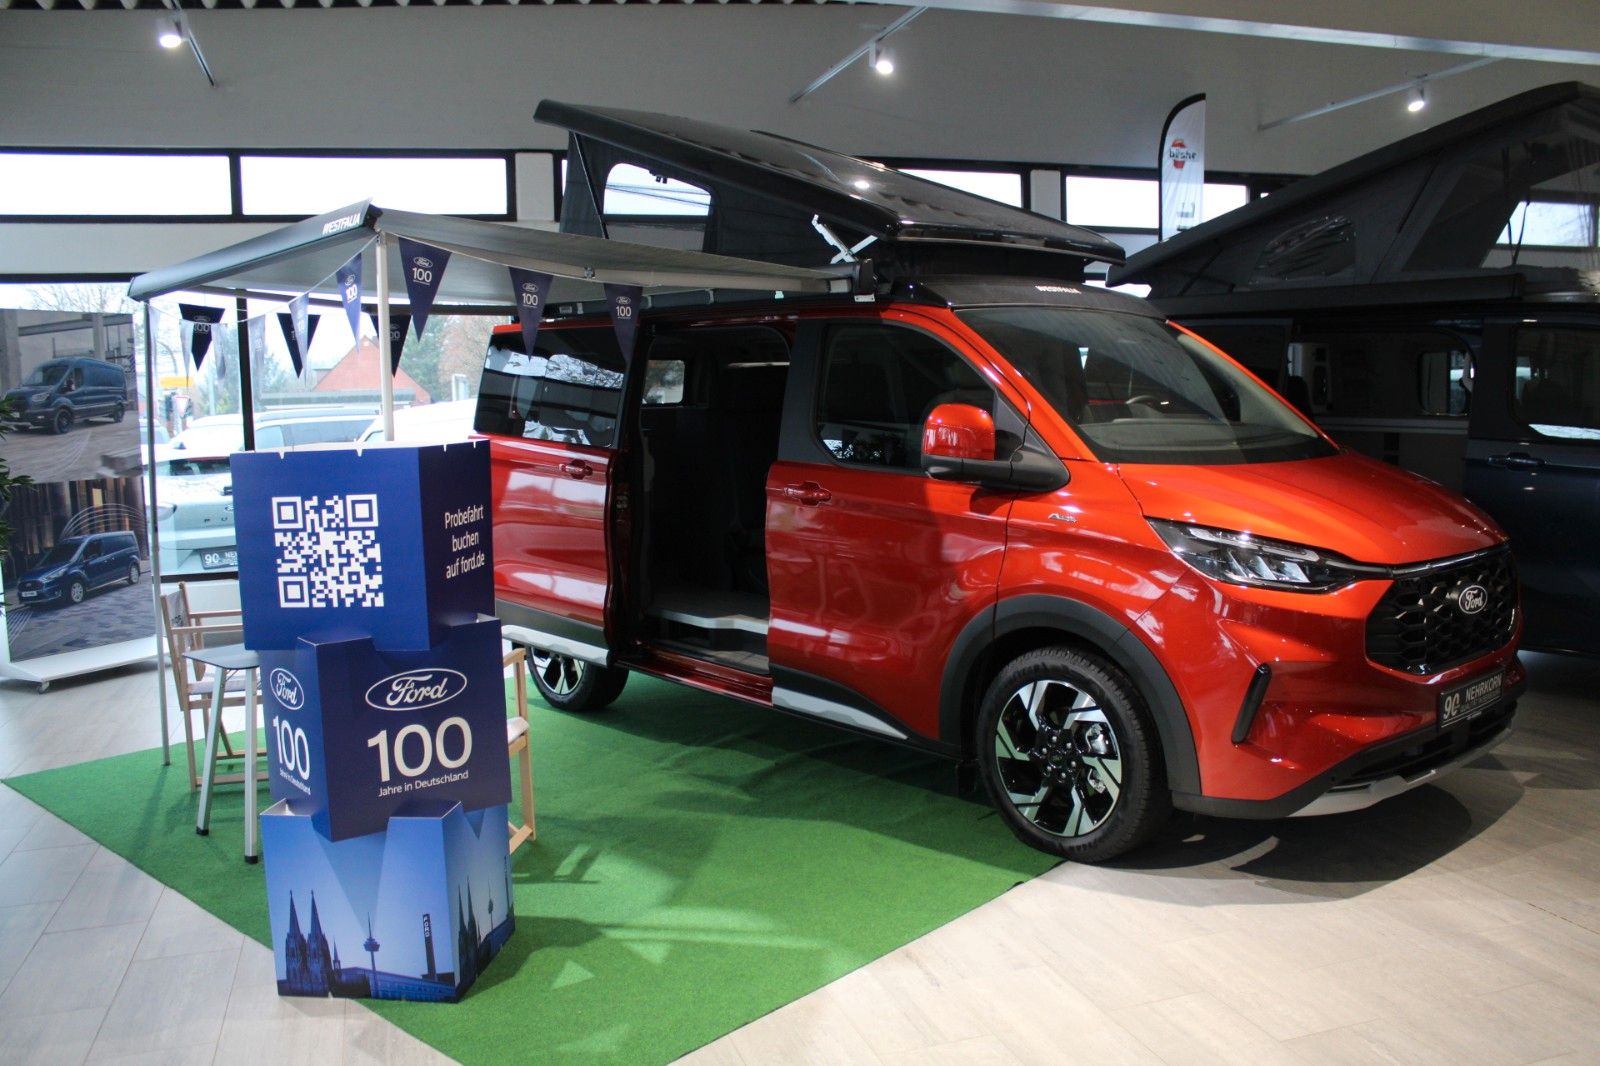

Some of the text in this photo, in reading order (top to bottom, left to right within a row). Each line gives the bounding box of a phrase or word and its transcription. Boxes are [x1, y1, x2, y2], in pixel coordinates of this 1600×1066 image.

[322, 212, 361, 236] WESTFALIA
[412, 267, 432, 283] 100
[522, 293, 538, 306] 100
[616, 305, 632, 317] 100
[444, 504, 484, 529] Probefahrt
[451, 531, 480, 552] buchen
[446, 550, 485, 579] auf ford.de
[386, 674, 448, 706] Ford
[1465, 672, 1502, 703] NEHRKORN
[272, 715, 310, 781] 100
[367, 716, 472, 782] 100
[378, 770, 469, 797] Jahre in Deutschland
